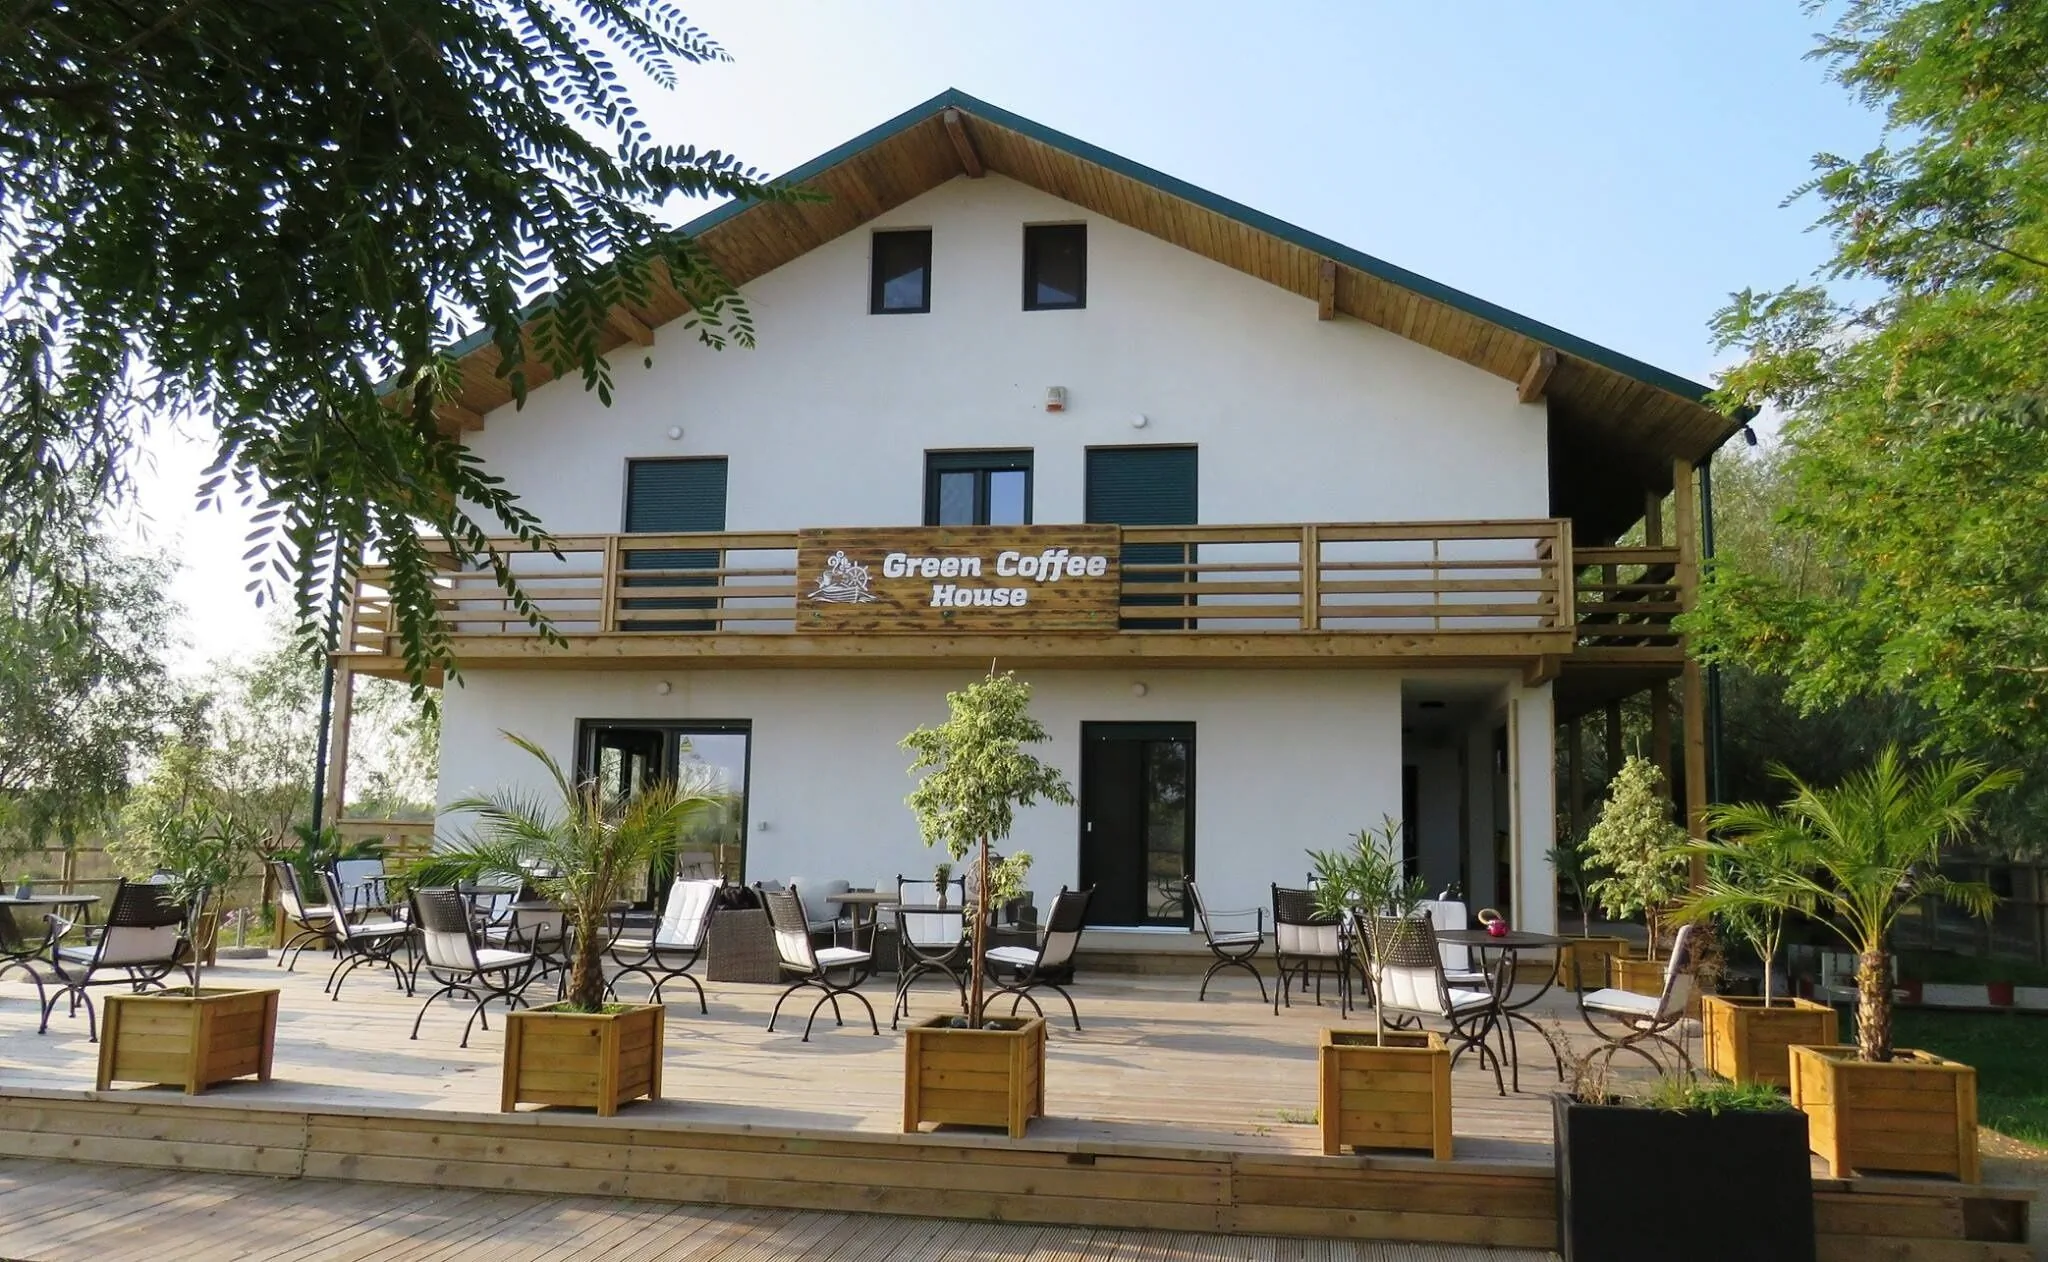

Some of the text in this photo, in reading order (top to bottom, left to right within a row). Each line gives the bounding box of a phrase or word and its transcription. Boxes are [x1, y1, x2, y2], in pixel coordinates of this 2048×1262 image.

[883, 549, 1106, 581] Green Coffee
[930, 584, 1028, 607] House
